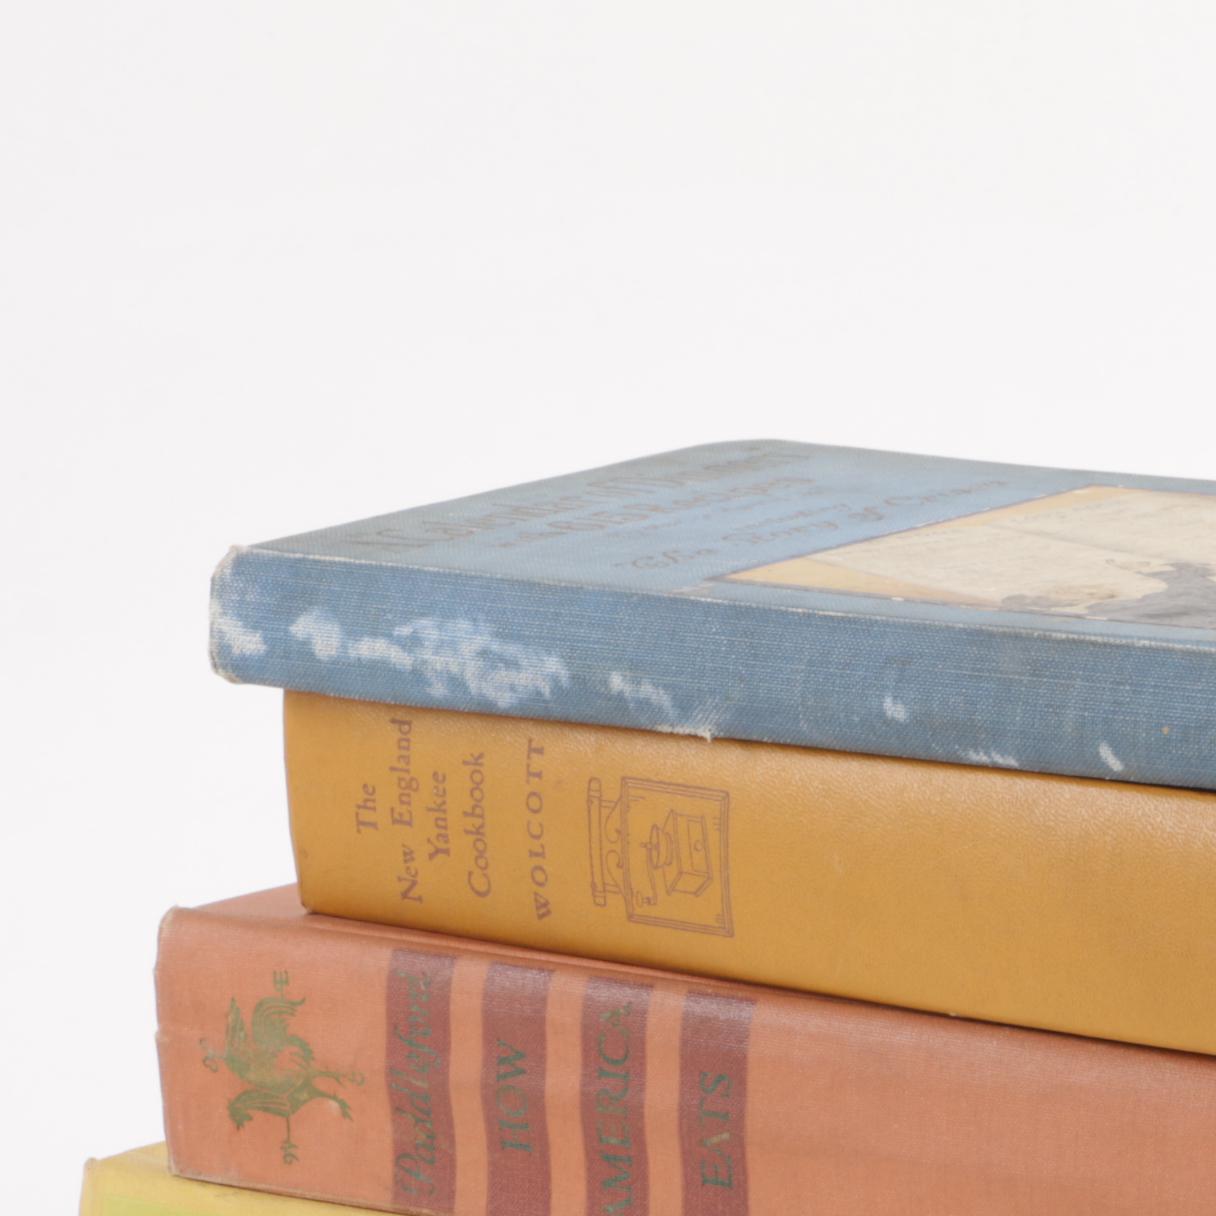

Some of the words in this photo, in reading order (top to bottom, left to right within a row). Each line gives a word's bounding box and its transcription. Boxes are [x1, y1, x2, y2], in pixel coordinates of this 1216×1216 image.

[355, 783, 380, 835] The
[389, 716, 419, 829] England
[428, 770, 451, 863] Yankee
[463, 751, 492, 899] Cookbook
[396, 843, 424, 904] New
[526, 738, 553, 922] WOLCOTT
[389, 969, 443, 1198] Paddleford
[495, 1039, 534, 1153] HOW
[700, 1070, 734, 1190] EATS
